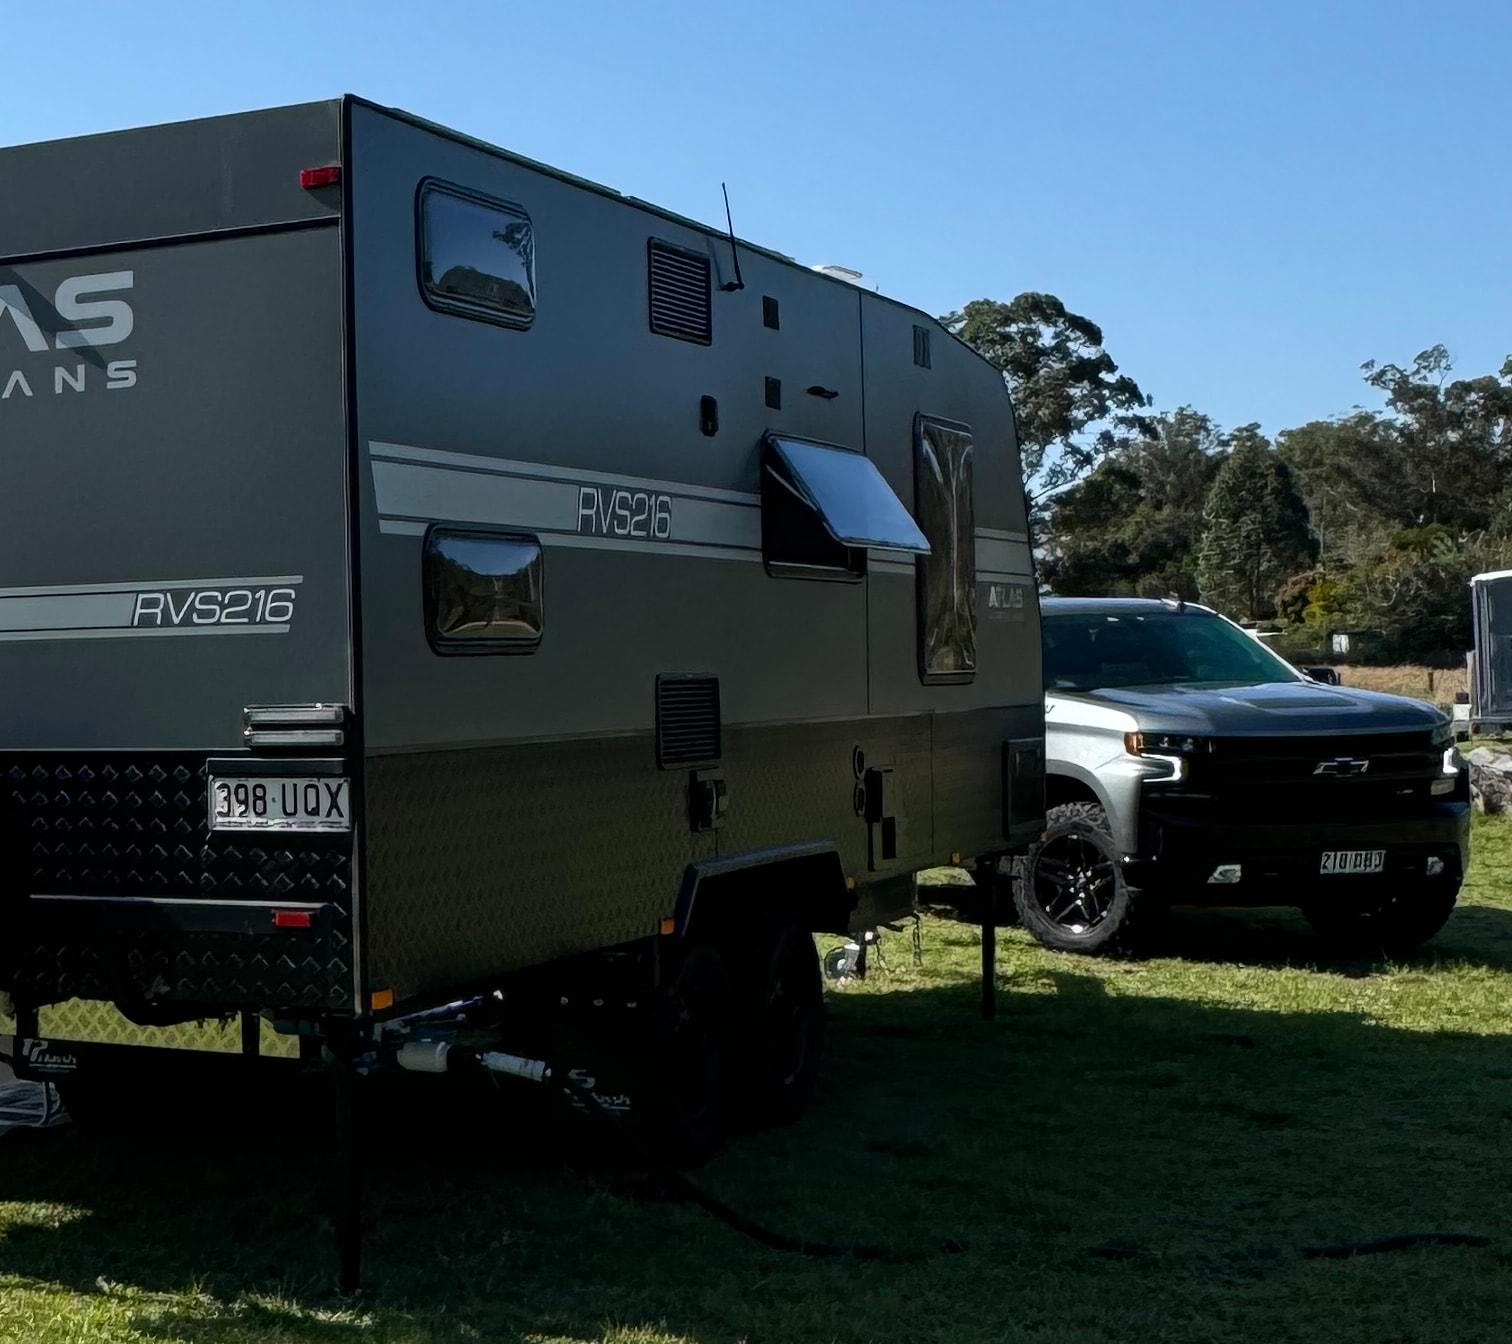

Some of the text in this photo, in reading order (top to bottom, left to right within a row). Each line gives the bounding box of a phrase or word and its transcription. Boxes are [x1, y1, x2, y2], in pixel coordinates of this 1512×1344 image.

[577, 486, 672, 539] RVS216
[132, 587, 296, 627] RVS216
[216, 782, 267, 818] 398
